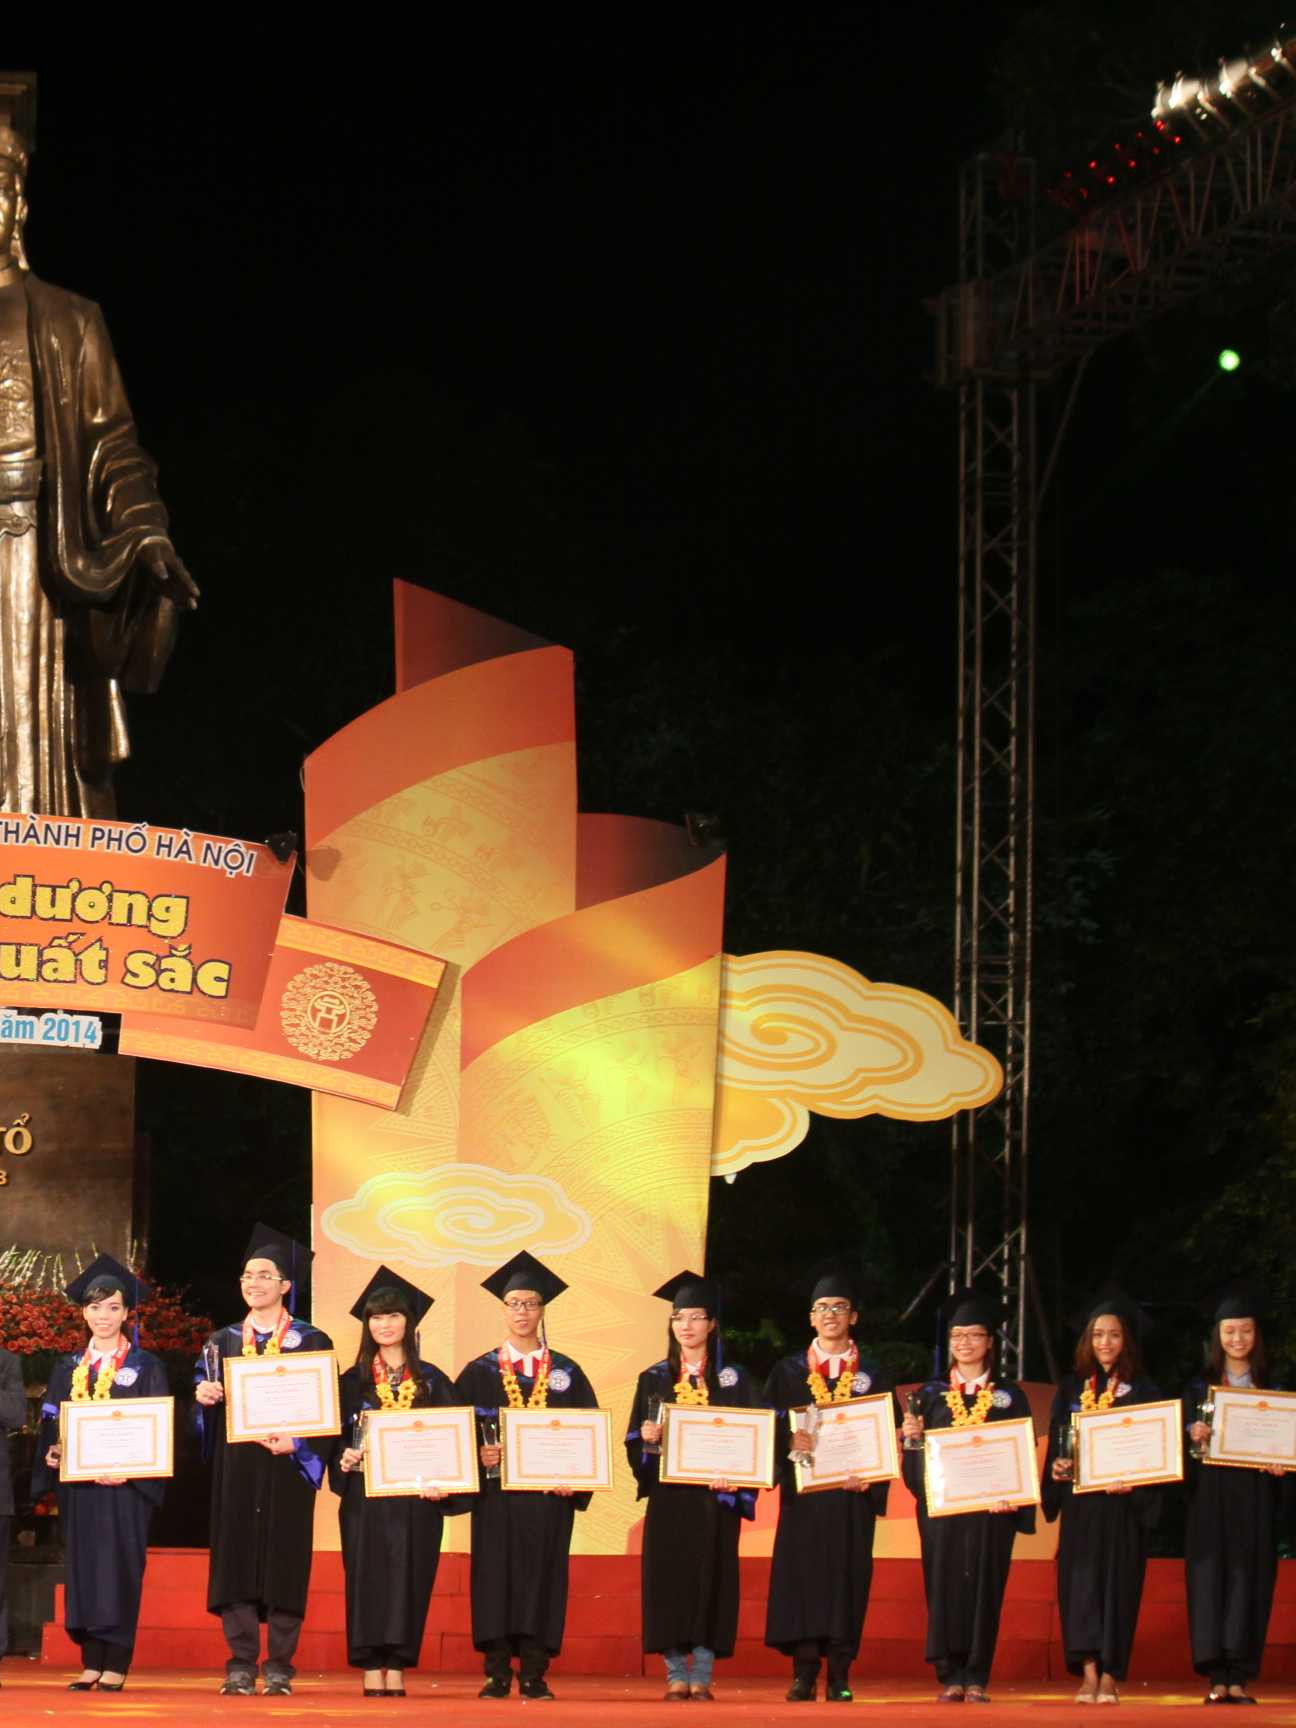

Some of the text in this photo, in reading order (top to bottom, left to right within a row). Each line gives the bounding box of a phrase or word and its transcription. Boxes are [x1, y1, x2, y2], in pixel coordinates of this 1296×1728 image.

[90, 822, 149, 854] PHỐ
[156, 829, 193, 861] HÀ
[201, 841, 255, 876] NỘI
[120, 944, 232, 998] sắc
[42, 1018, 98, 1044] 2014
